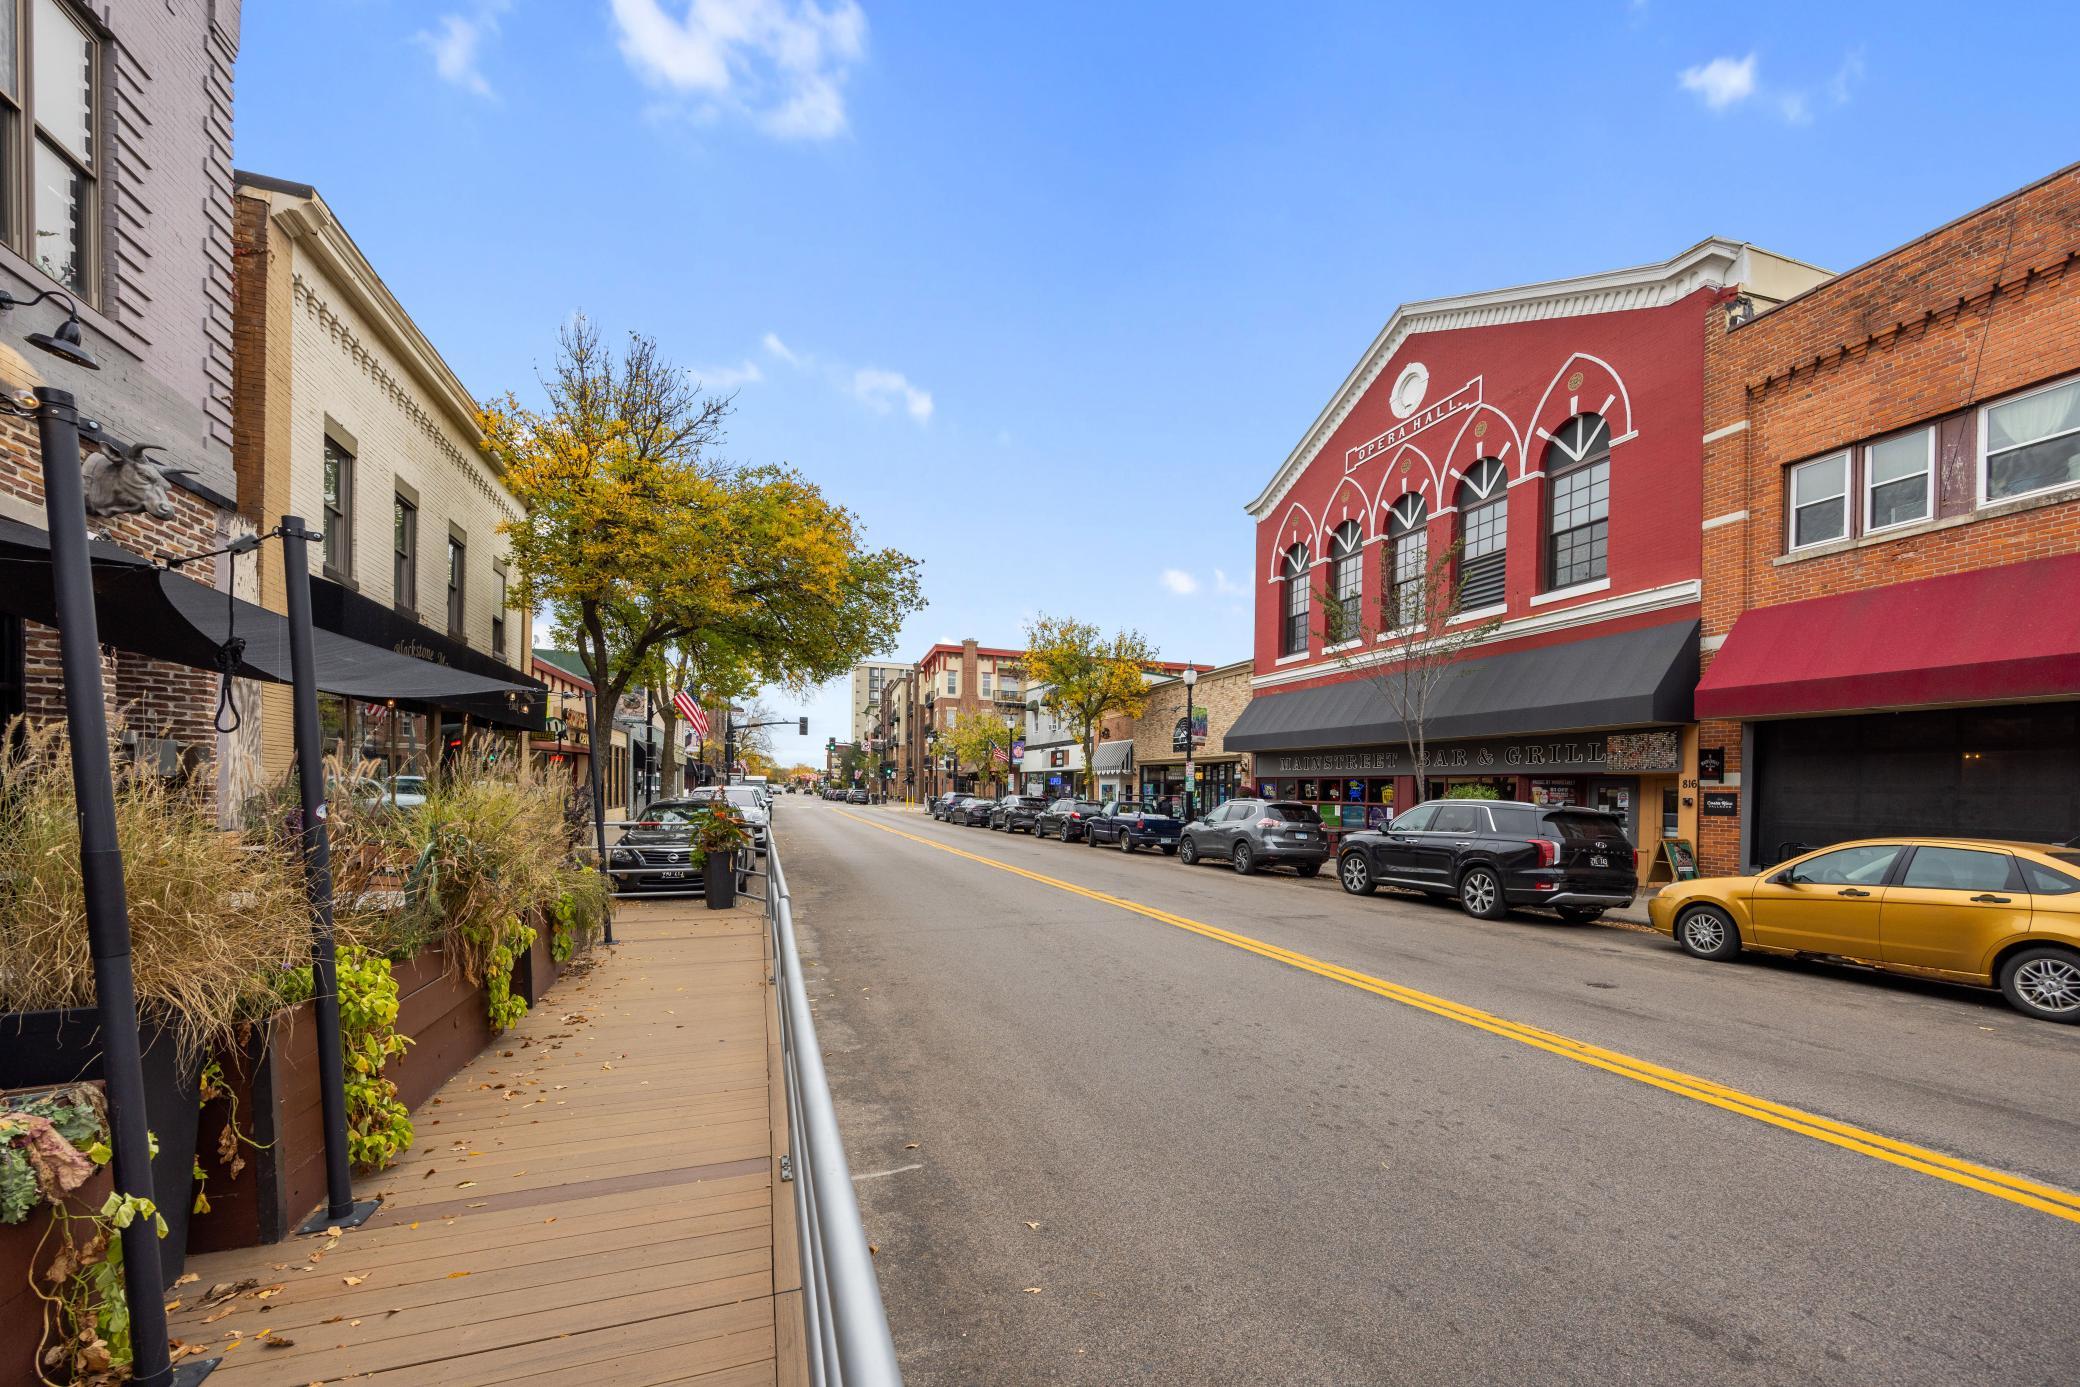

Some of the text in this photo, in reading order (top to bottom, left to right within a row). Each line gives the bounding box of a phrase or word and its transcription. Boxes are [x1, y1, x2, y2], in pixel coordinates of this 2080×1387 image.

[1359, 427, 1405, 460] OPERA
[1280, 743, 1607, 771] MAINSTREET BAR & GRILL
[1682, 779, 1698, 789] 816
